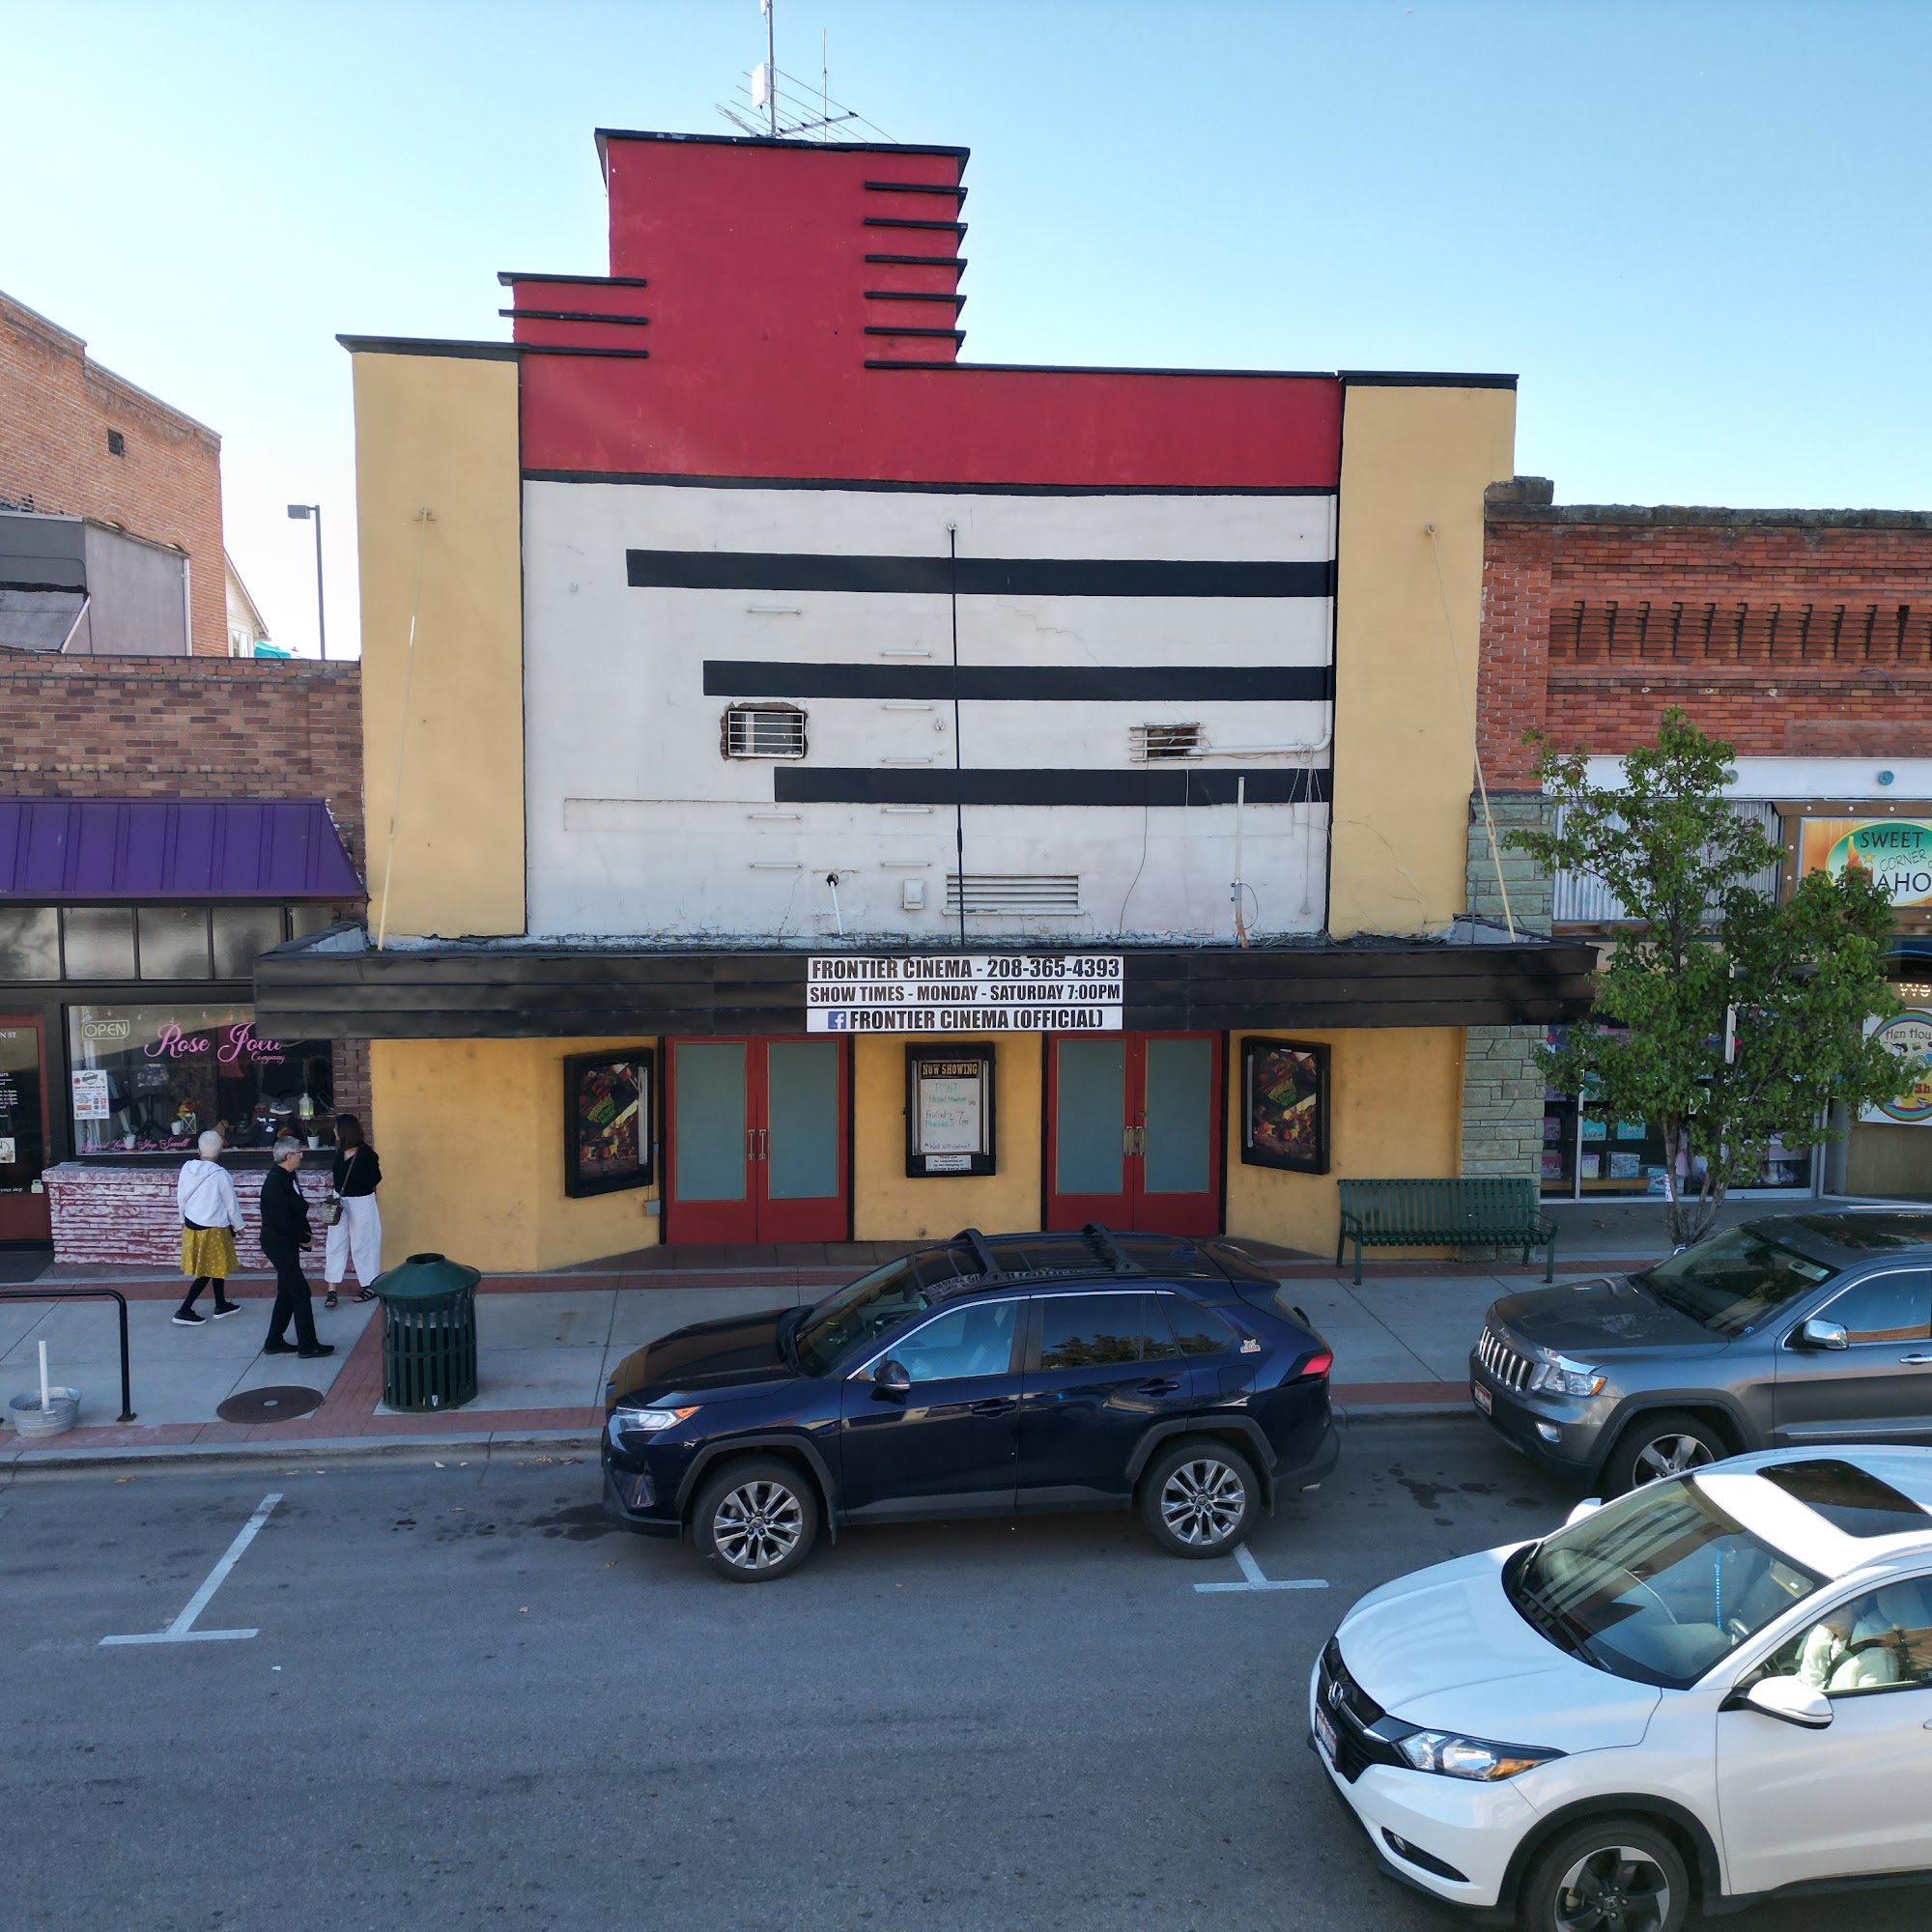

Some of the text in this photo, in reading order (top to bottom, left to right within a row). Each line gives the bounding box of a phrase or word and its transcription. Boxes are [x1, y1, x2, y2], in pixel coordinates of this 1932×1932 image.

[1860, 831, 1924, 848] SWEET
[1879, 849, 1927, 872] CORNER
[812, 959, 898, 980] FRONTIER
[902, 958, 973, 979] CINEMA
[986, 957, 1121, 978] 208-365-4393
[810, 986, 857, 1003] SHOW
[859, 985, 905, 1003] TIMES
[917, 984, 979, 1002] MONDAY
[990, 984, 1065, 1001] SATURDAY
[1067, 983, 1121, 1000] 7:00PM
[849, 1010, 935, 1030] FRONTIER
[940, 1009, 1009, 1029] CINEMA
[1013, 1009, 1103, 1028] (OFFICIAL)
[84, 1023, 127, 1037] OPEN
[1886, 1029, 1907, 1040] Hen
[144, 1023, 211, 1059] Rose
[250, 1051, 286, 1065] Company
[923, 1063, 979, 1075] NOW SHOWING
[158, 1137, 191, 1151] Small
